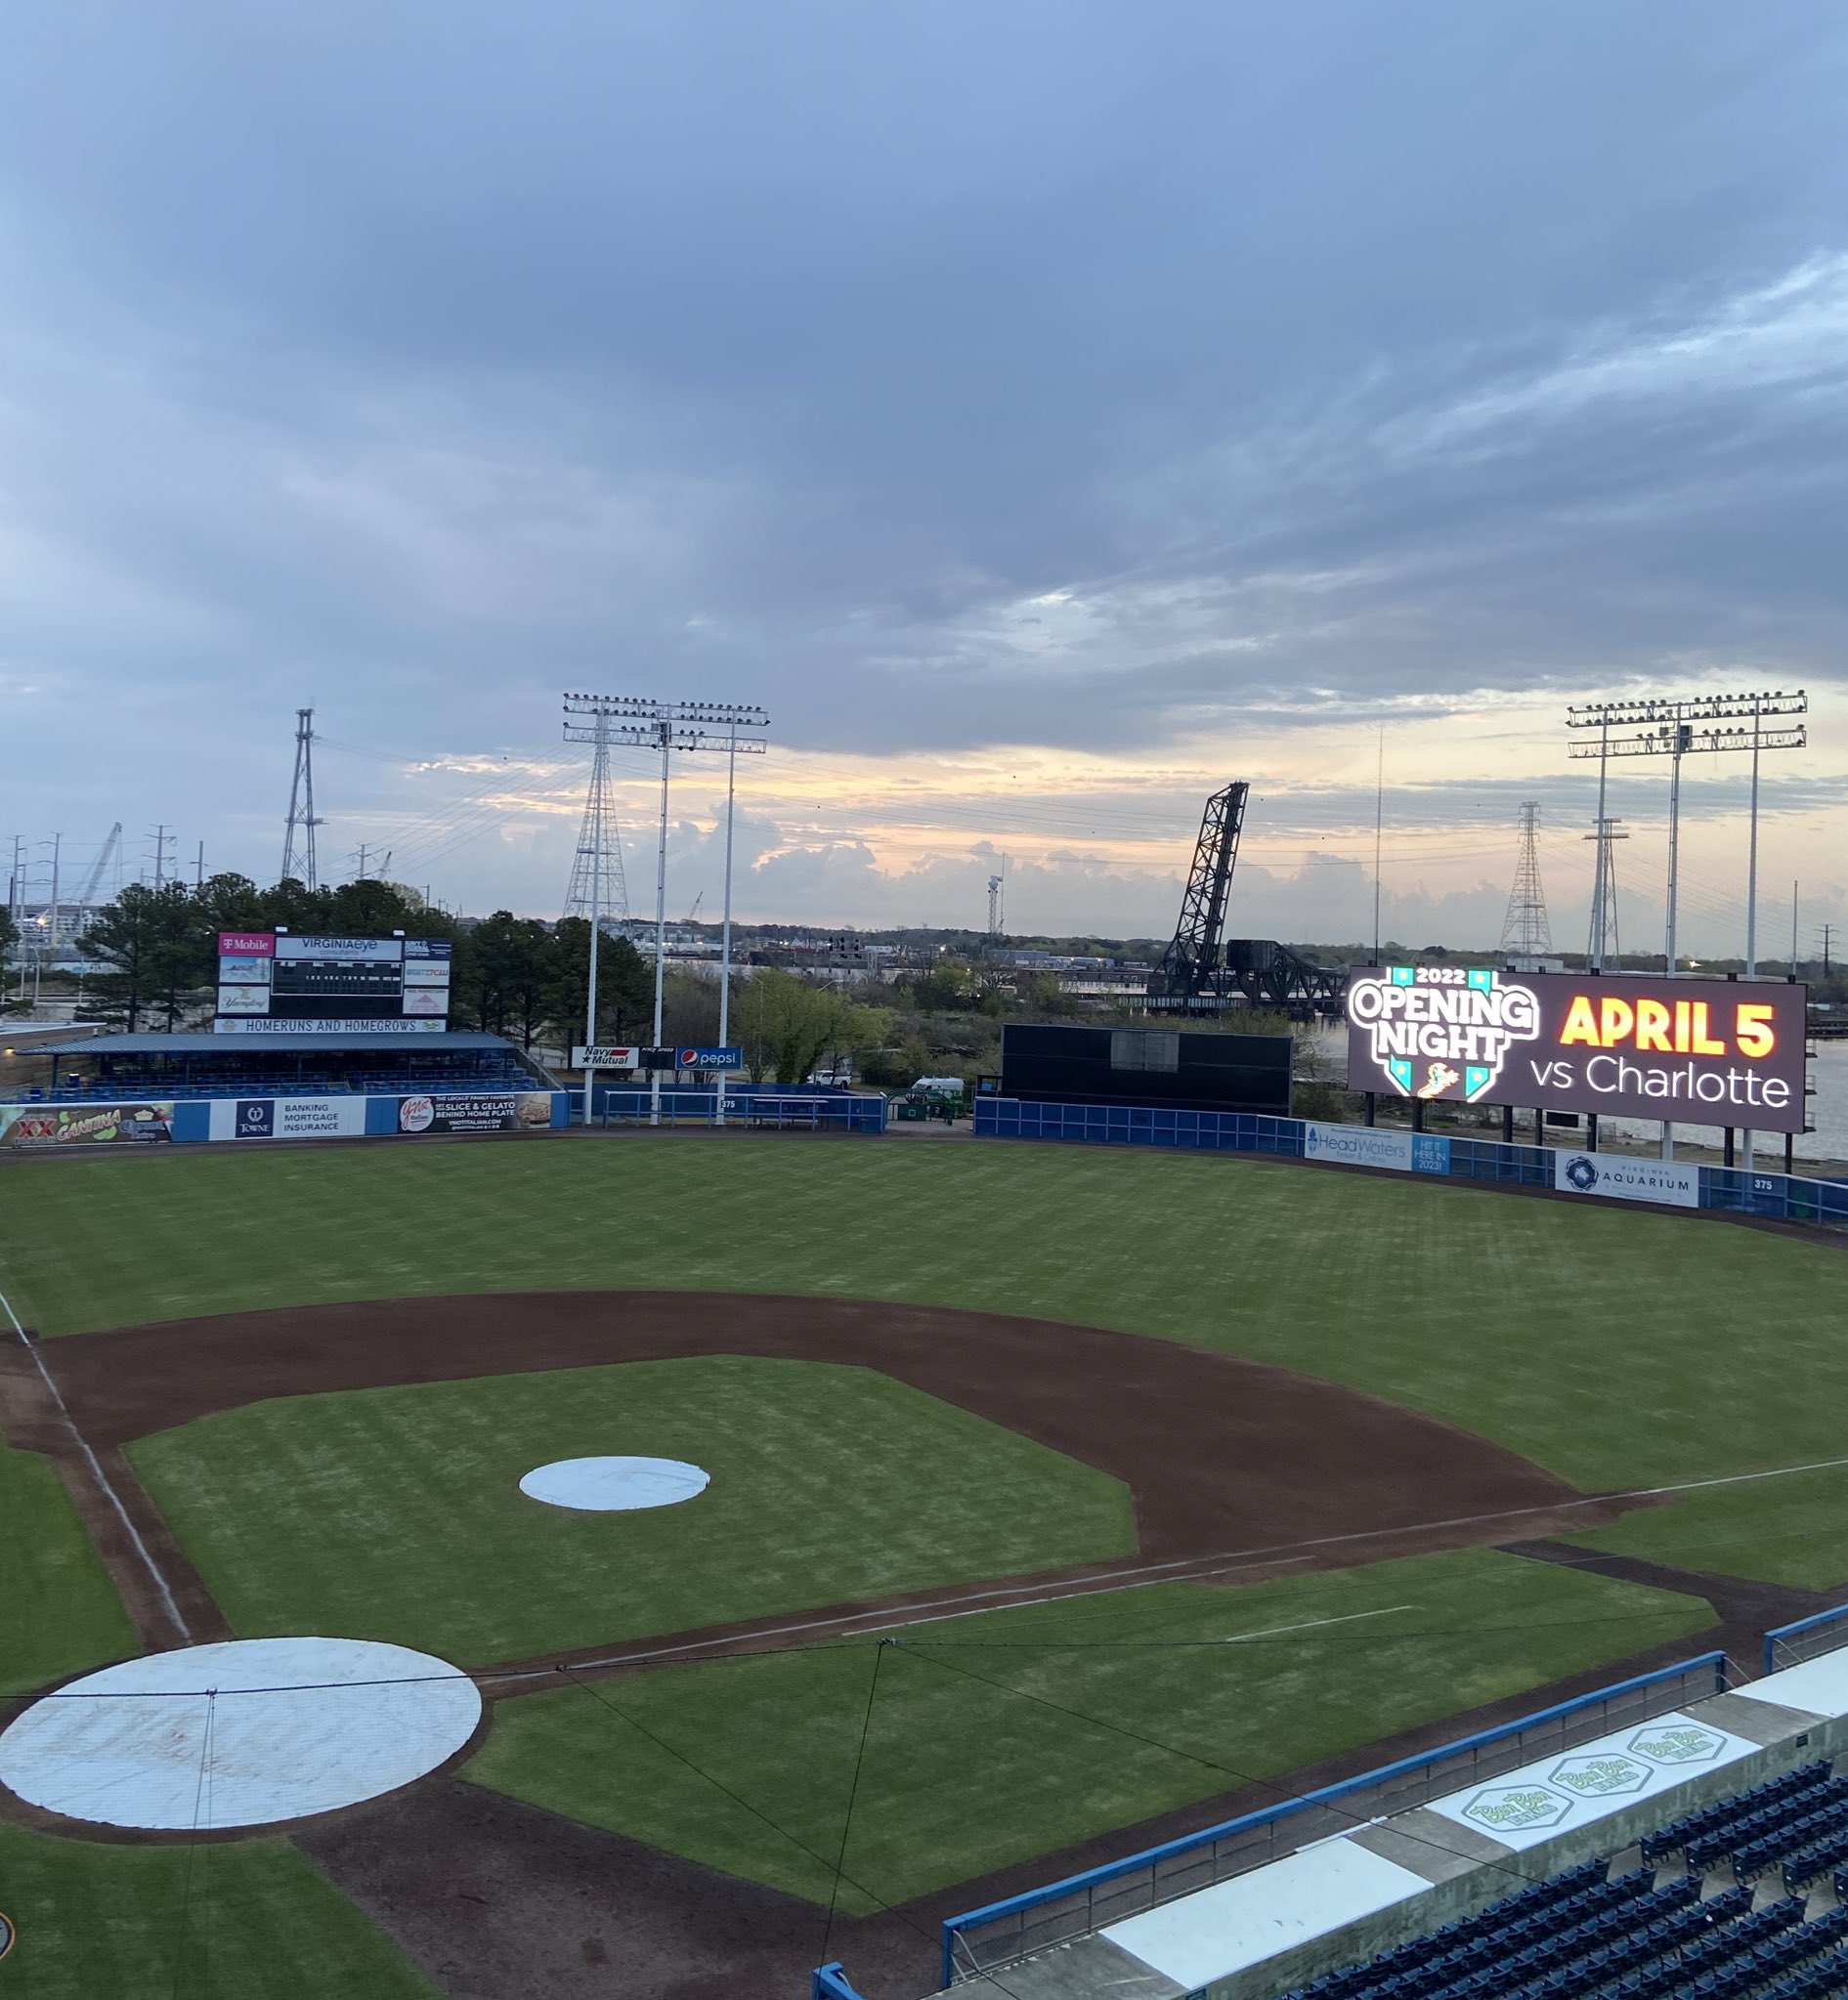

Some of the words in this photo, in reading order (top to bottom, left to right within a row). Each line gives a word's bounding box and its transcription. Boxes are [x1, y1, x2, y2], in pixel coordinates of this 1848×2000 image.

[235, 939, 269, 950] Mobile
[1416, 967, 1467, 985] 2022
[1354, 987, 1534, 1030] OPENING
[246, 1020, 313, 1032] HOMERUNS
[317, 1020, 341, 1032] AND
[345, 1020, 416, 1032] HOMEGROWS
[1559, 995, 1726, 1056] APRIL
[1735, 1002, 1776, 1059] 5
[1377, 1020, 1508, 1063] NIGHT
[584, 1046, 611, 1057] Navy
[591, 1055, 628, 1065] Mutual
[700, 1052, 736, 1066] pepsi
[1529, 1059, 1574, 1090] vs
[1585, 1054, 1792, 1109] Charlotte
[284, 1103, 329, 1113] BANKING
[284, 1113, 339, 1123] MORTGAGE
[17, 1119, 57, 1138] XX
[56, 1109, 122, 1141] CANTINA
[283, 1122, 340, 1131] INSURANCE
[1319, 1134, 1406, 1158] HeadWaters
[1420, 1140, 1433, 1150] HIT
[1434, 1142, 1441, 1151] IT
[1414, 1149, 1435, 1161] HERE
[1436, 1152, 1446, 1161] IN
[1621, 1165, 1670, 1176] VIRGINIA
[1603, 1171, 1690, 1191] AQUARIUM
[1754, 1178, 1773, 1190] 375
